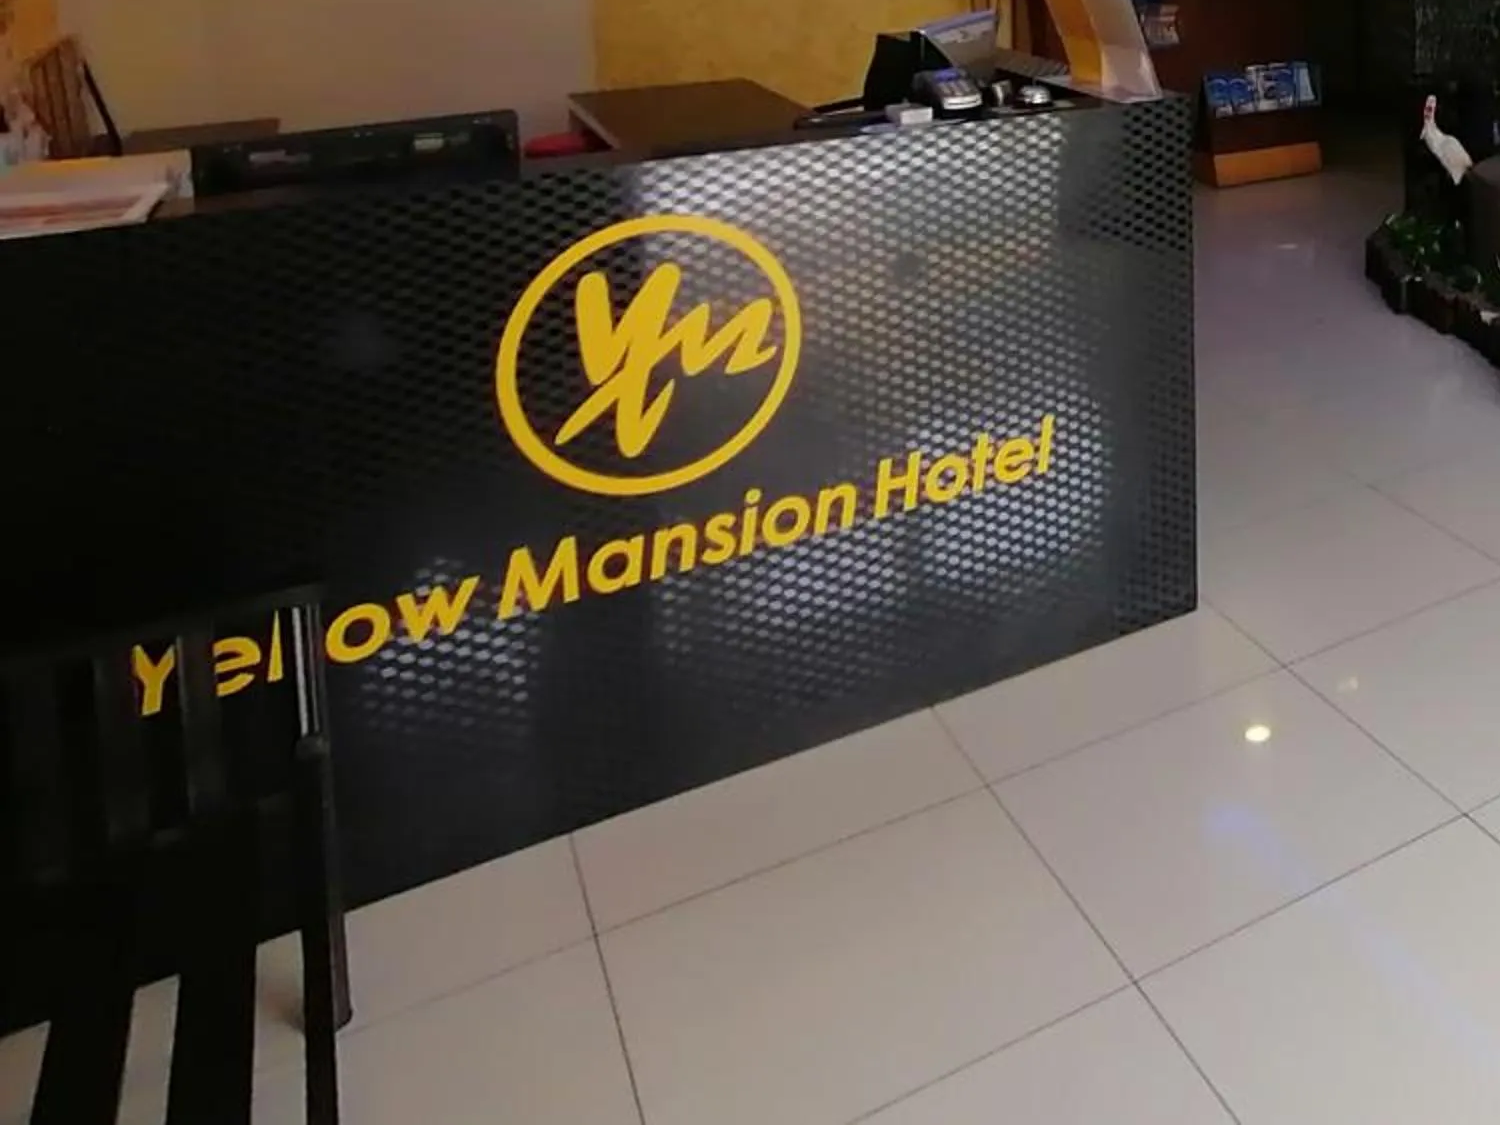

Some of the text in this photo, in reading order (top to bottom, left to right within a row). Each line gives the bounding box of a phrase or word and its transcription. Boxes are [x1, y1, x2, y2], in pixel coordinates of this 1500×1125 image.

[131, 413, 1055, 716] Yelow Mansion Hotel
